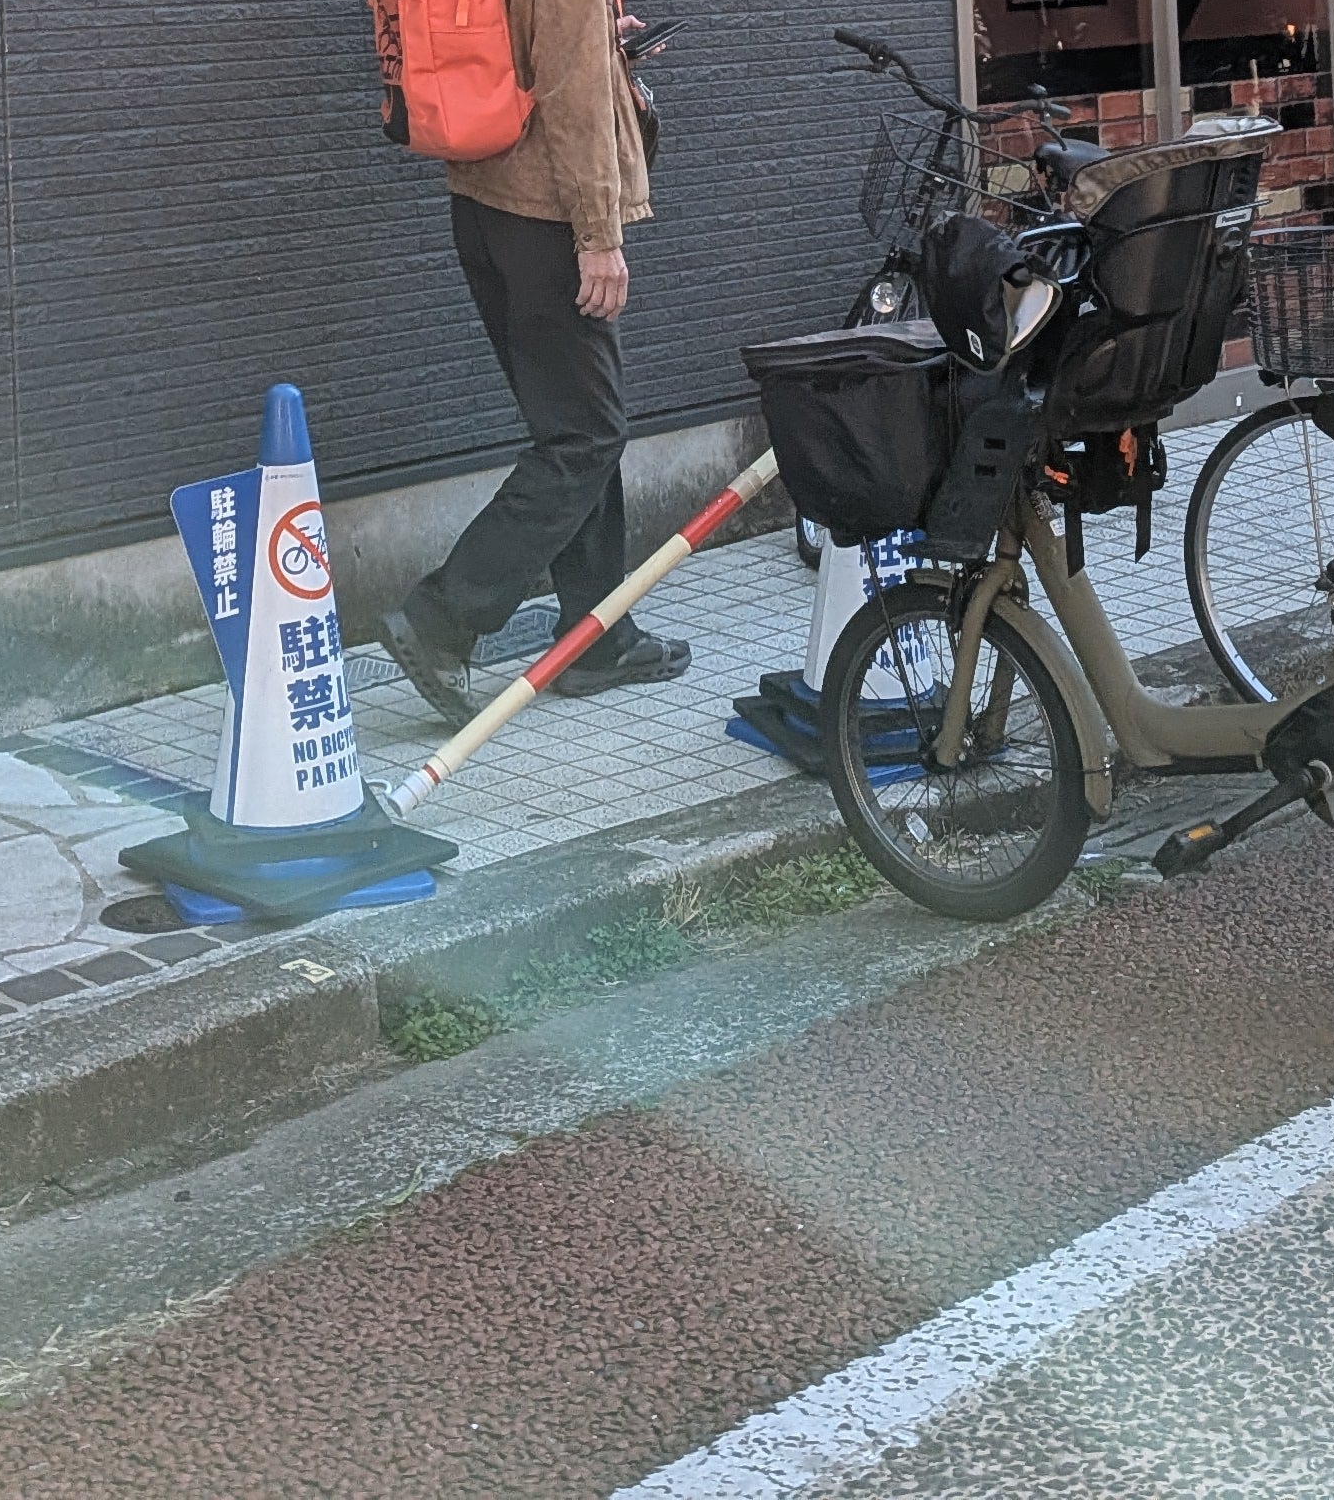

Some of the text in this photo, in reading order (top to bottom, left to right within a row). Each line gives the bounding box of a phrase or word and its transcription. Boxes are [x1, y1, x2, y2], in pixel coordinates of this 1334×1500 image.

[210, 487, 240, 620] 駐輪禁止
[292, 739, 318, 764] NO
